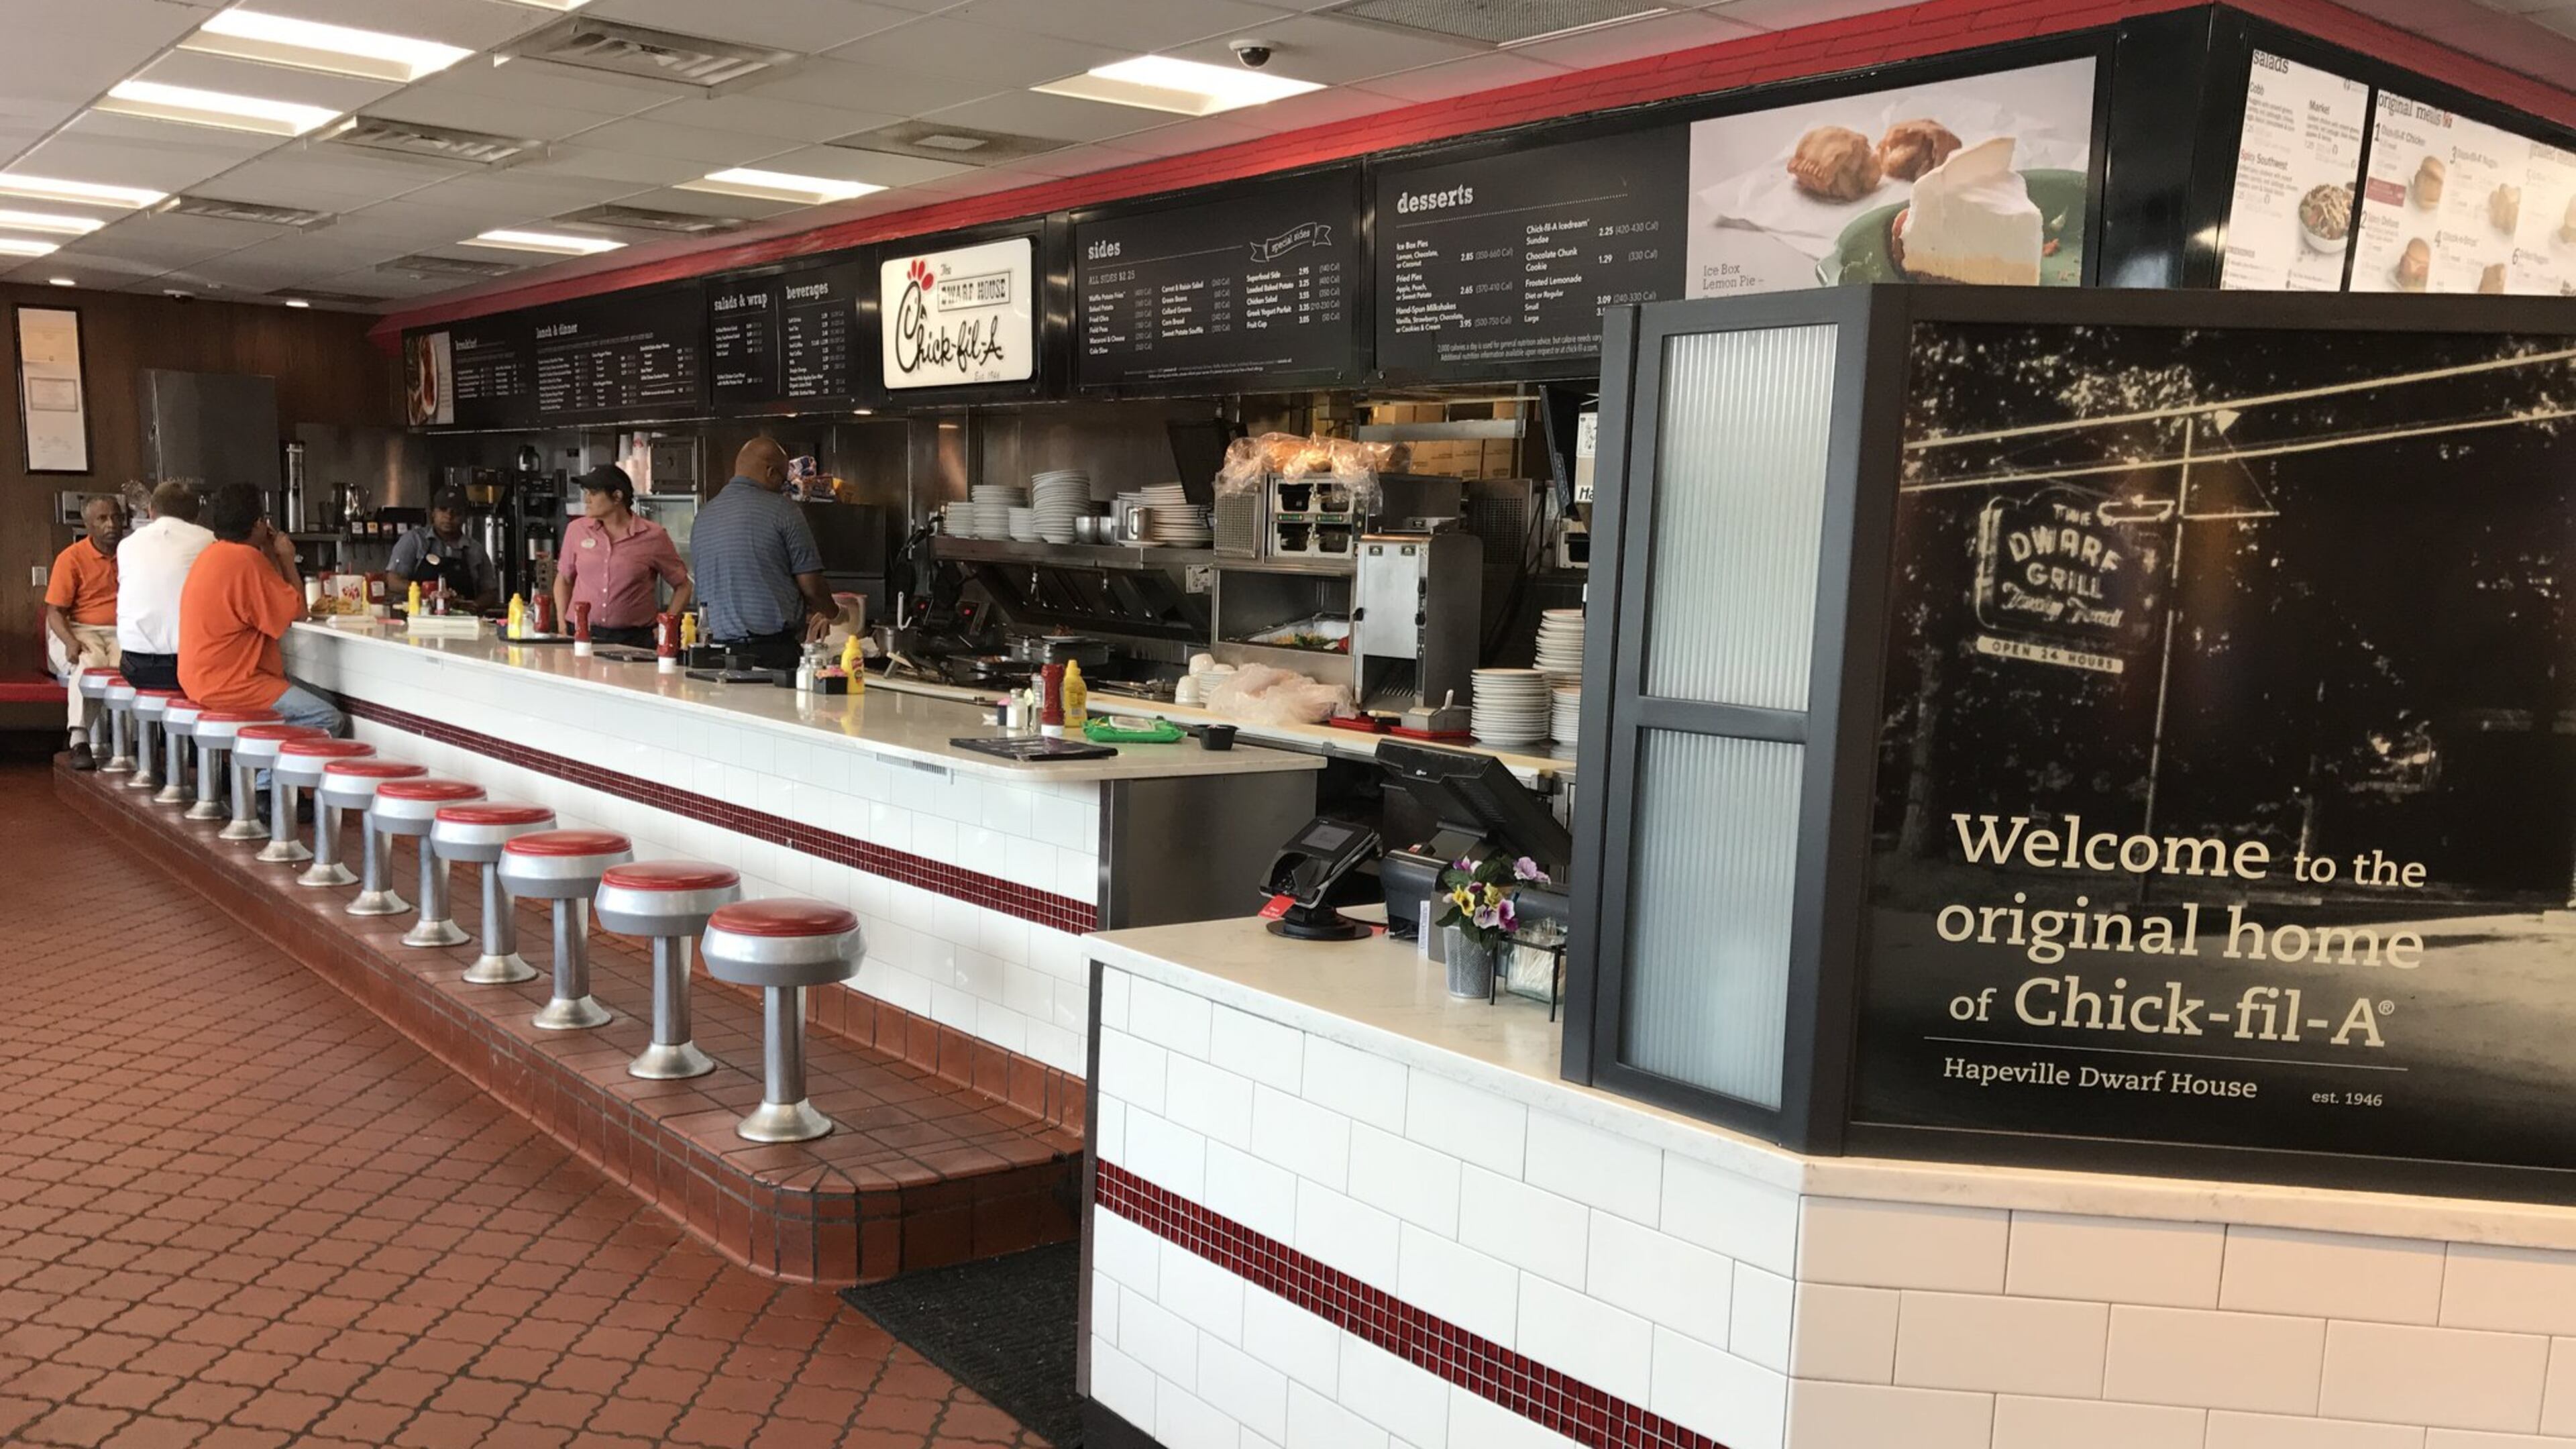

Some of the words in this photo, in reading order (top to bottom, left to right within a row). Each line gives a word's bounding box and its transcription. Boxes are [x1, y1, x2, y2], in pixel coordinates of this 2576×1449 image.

[2253, 50, 2289, 74] salads
[2249, 81, 2264, 95] Cobb
[2309, 99, 2330, 115] Market
[2378, 93, 2412, 116] original
[2374, 123, 2381, 142] 1
[2257, 153, 2288, 170] Southwest
[2450, 146, 2457, 164] 3
[1397, 184, 1474, 214] desserts
[2360, 210, 2368, 229] 2
[1526, 222, 1558, 235] Chick-fil-A
[1599, 226, 1613, 237] 2.25
[1615, 223, 1644, 235] (420-430
[1645, 221, 1659, 231] Cal)
[1271, 234, 1293, 253] special
[1293, 229, 1310, 241] sides
[1405, 241, 1416, 250] Box
[1417, 240, 1428, 248] Pies
[1526, 235, 1549, 246] Sundae
[2435, 231, 2442, 248] 4
[1088, 239, 1120, 260] sides
[1396, 253, 1413, 261] Lemon,
[1413, 250, 1439, 259] Chocolate,
[1460, 252, 1474, 262] 2.85
[1501, 248, 1513, 257] Cal)
[1525, 250, 1556, 261] Chocolate
[1557, 247, 1578, 258] Chunk
[1599, 254, 1613, 264] 1.29
[1629, 251, 1643, 262] (330
[1644, 249, 1658, 260] Cal)
[2512, 248, 2519, 265] 6
[941, 264, 951, 276] The
[1402, 260, 1421, 268] Coconut
[1525, 262, 1548, 272] Cookie
[1703, 265, 1719, 276] Ice
[1721, 263, 1740, 275] Box
[1088, 275, 1099, 284] ALL
[1101, 272, 1118, 284] SIDES
[1246, 272, 1270, 282] Superfood
[1270, 270, 1281, 279] Side
[1299, 266, 1309, 276] 2.95
[1396, 274, 1410, 282] Fried
[1411, 273, 1422, 281] Pies
[1525, 277, 1548, 288] Frosted
[1550, 274, 1582, 285] Lemonade
[977, 278, 1006, 300] HOUSE
[1246, 285, 1263, 294] Loaded
[1264, 282, 1278, 292] Baked
[1279, 282, 1294, 290] Potato
[1396, 285, 1411, 294] Apple,
[1411, 283, 1427, 291] Peach,
[1460, 286, 1473, 295] 2.65
[1476, 283, 1500, 294] (370-410
[1501, 281, 1513, 291] Cal)
[1703, 278, 1737, 290] Lemon
[1739, 275, 1756, 286] Pie
[786, 282, 828, 300] beverages
[1525, 292, 1536, 300] Diet
[1543, 289, 1564, 300] Regular
[1597, 295, 1611, 305] 3.09
[1613, 292, 1642, 304] (240-330
[1643, 291, 1656, 301] Cal)
[714, 295, 738, 311] salads
[739, 293, 745, 307] &
[747, 292, 768, 309] wrap
[1246, 297, 1265, 306] Chicken
[1265, 294, 1278, 304] Salad
[1524, 303, 1539, 311] Small
[1246, 309, 1260, 317] Greek
[1261, 309, 1276, 317] Yogurt
[1276, 305, 1292, 314] Parfait
[1396, 306, 1426, 315] Hand-Spun
[1426, 302, 1456, 312] Milkshakes
[1246, 321, 1257, 329] Fruit
[1257, 320, 1267, 329] Cup
[1413, 315, 1438, 324] Strawberry,
[1439, 313, 1464, 321] Chocolate,
[1459, 319, 1472, 328] 3.95
[1500, 315, 1512, 325] Cal)
[1524, 315, 1539, 324] Large
[553, 324, 558, 336] &
[558, 323, 578, 335] dinner
[896, 280, 1004, 373] Chick-fil-A
[1401, 325, 1419, 333] Cookies
[2053, 504, 2092, 526] THE
[2008, 525, 2123, 573] DWARF
[2027, 562, 2103, 599] GRILL
[1992, 641, 2031, 656] OPEN
[2041, 649, 2058, 660] 24
[2068, 653, 2113, 669] HOURS
[1951, 813, 2271, 879] Welcome
[2293, 850, 2337, 883] to
[2353, 849, 2427, 888] the
[1936, 892, 2200, 964] original
[2222, 904, 2425, 969] home
[1949, 987, 1997, 1021] of
[2015, 975, 2395, 1048] Chick-fil-A®
[1943, 1057, 2070, 1090] Hapeville
[2078, 1065, 2166, 1093] Dwarf
[2169, 1073, 2259, 1099] House
[2311, 1091, 2339, 1105] est.
[2344, 1092, 2383, 1107] 1946
